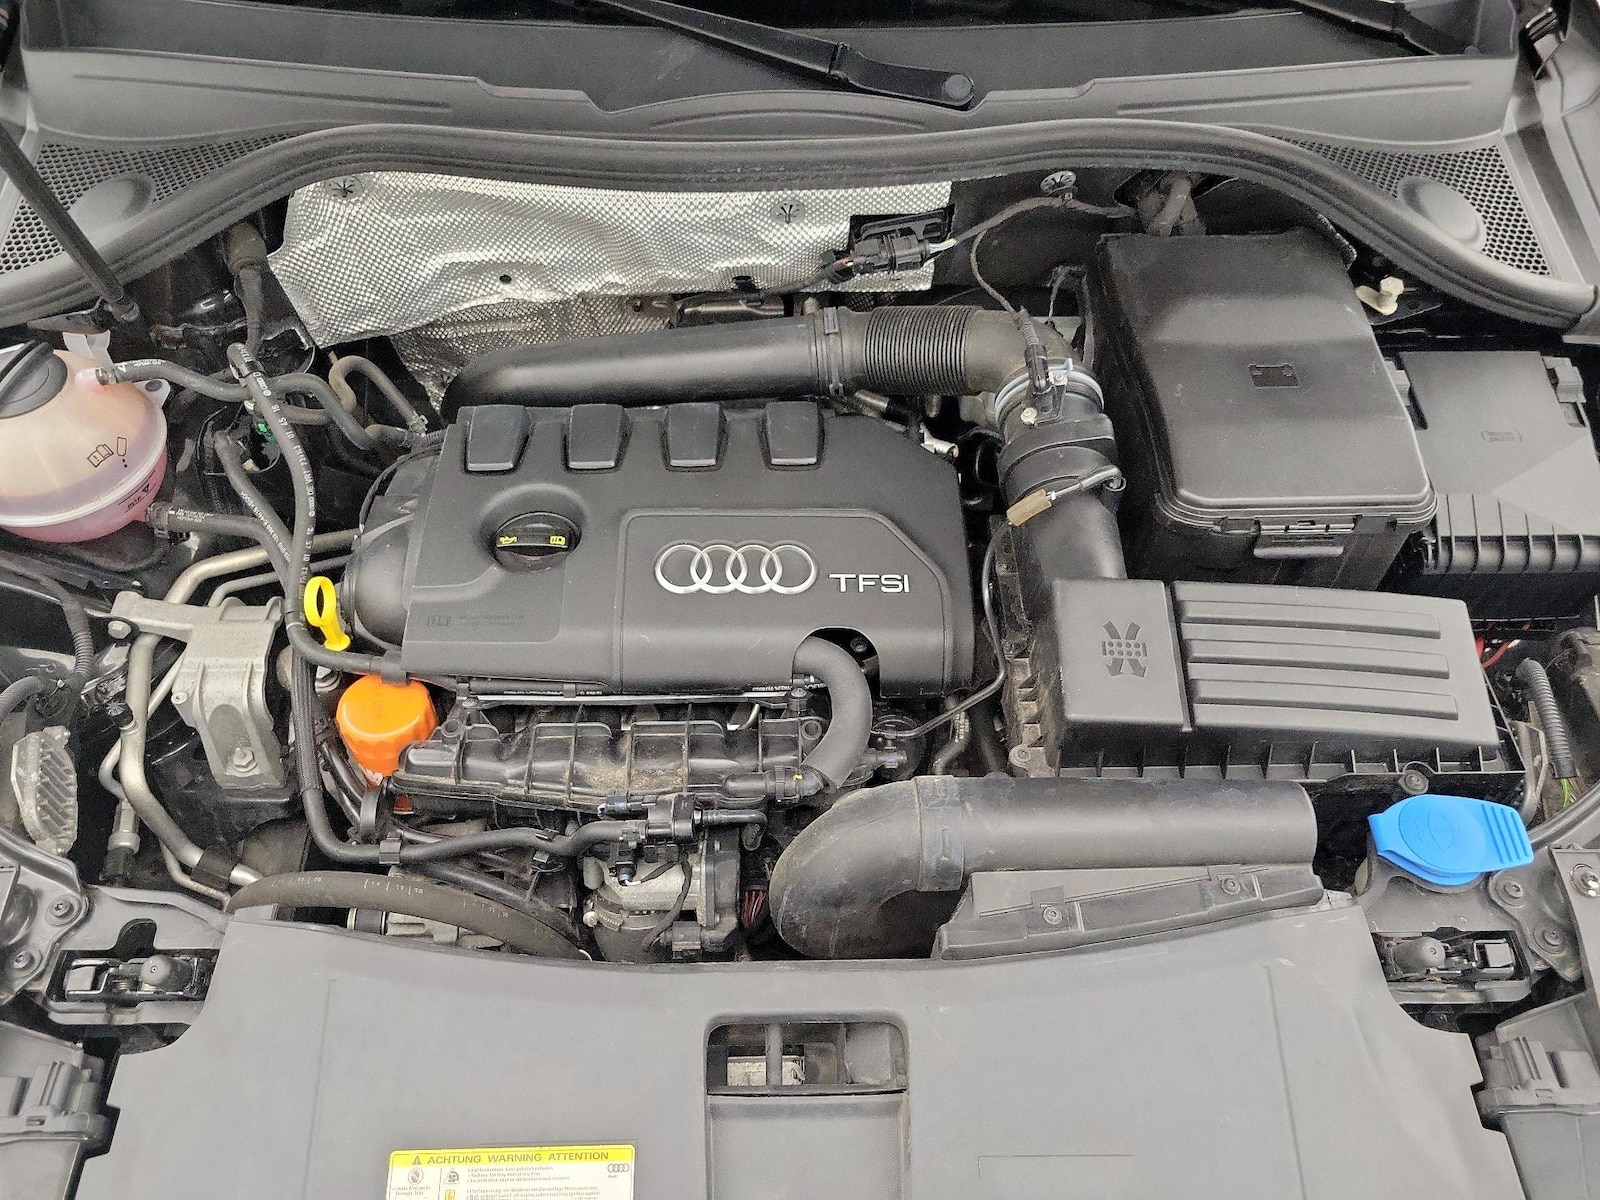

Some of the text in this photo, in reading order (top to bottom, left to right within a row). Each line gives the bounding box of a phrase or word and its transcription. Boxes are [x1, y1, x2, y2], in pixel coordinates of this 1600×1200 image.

[127, 496, 142, 509] min
[828, 573, 910, 593] TFSI
[427, 1151, 609, 1165] ACHTUNG WARNING ATTENTION
